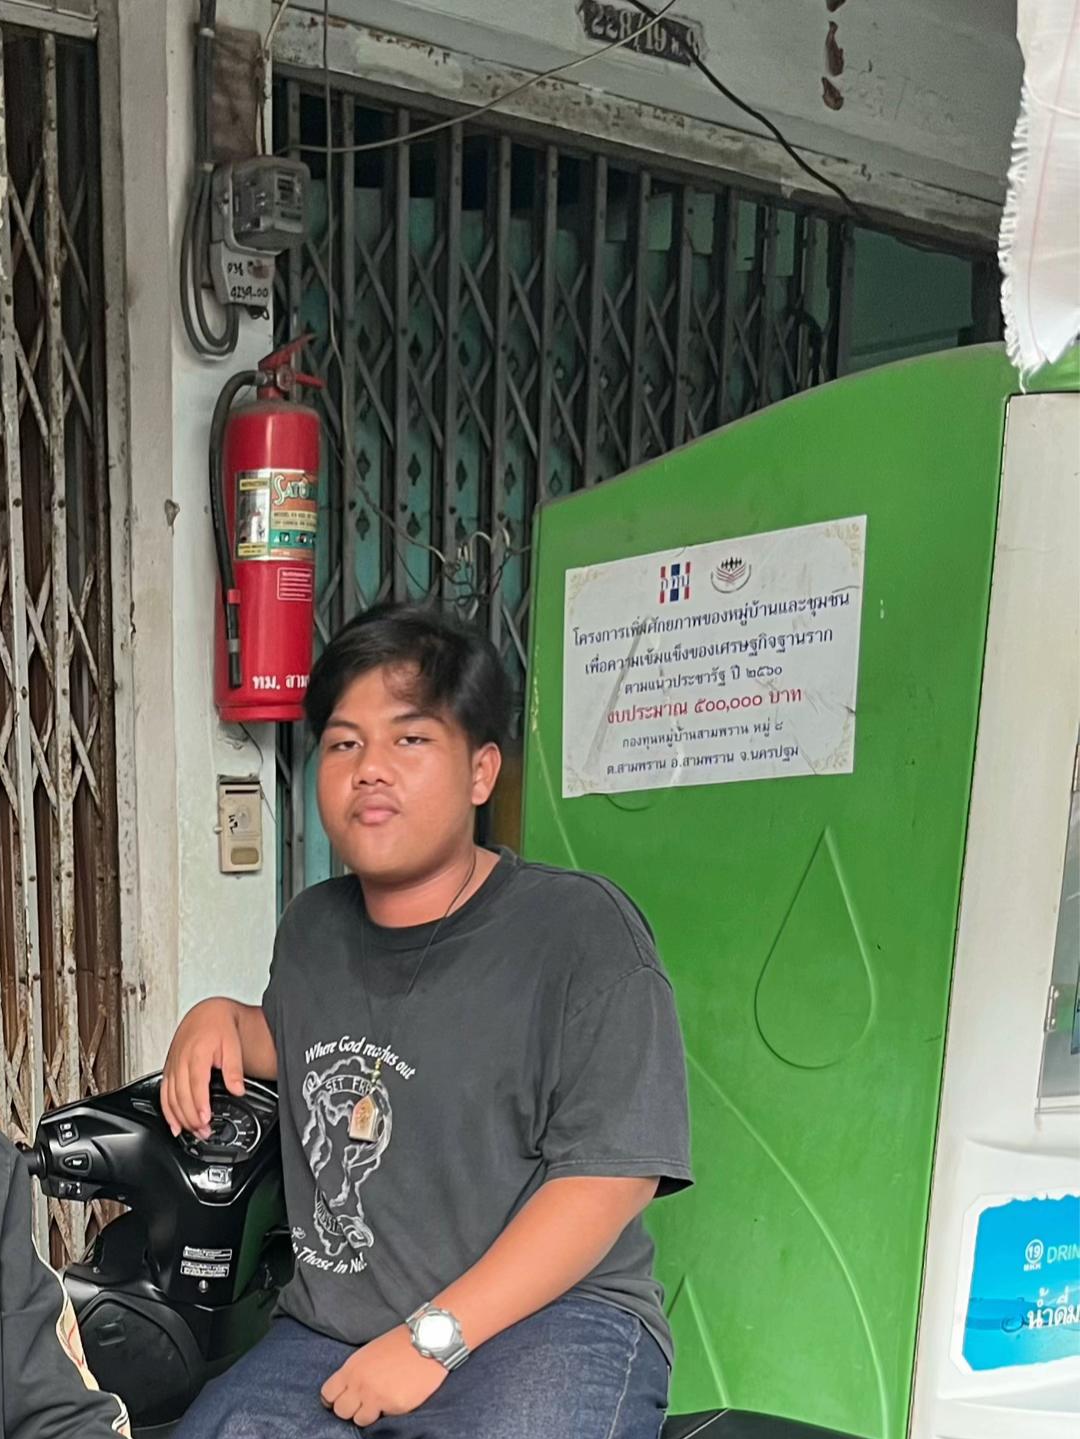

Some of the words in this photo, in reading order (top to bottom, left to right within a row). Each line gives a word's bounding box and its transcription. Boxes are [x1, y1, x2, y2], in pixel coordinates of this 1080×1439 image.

[607, 701, 688, 724] งบประมาณ
[768, 688, 802, 704] บาท
[305, 1040, 338, 1065] Where
[338, 1035, 366, 1054] God
[395, 1060, 417, 1081] out
